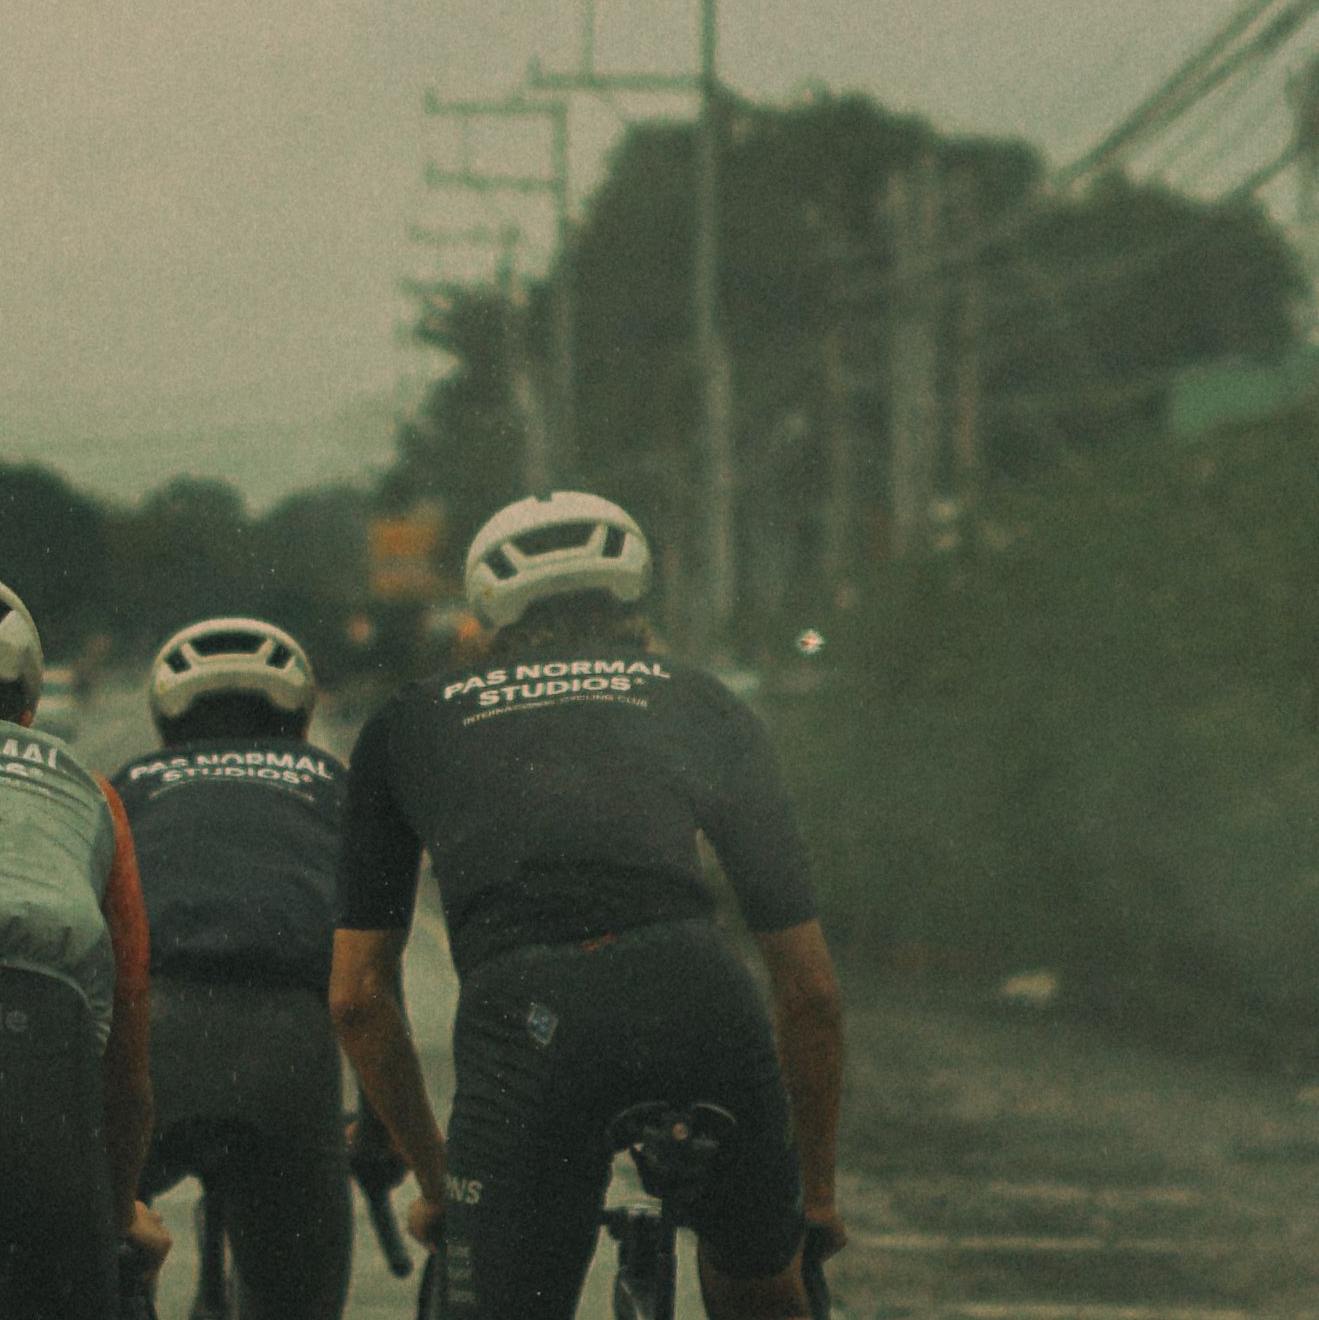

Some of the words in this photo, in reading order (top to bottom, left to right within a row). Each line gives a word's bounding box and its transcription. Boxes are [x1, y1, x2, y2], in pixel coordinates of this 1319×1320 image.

[444, 669, 508, 700] PAS
[516, 660, 671, 680] NORMAL
[617, 695, 648, 709] CLUB
[130, 757, 189, 780] PAS
[196, 752, 333, 780] NORMAL
